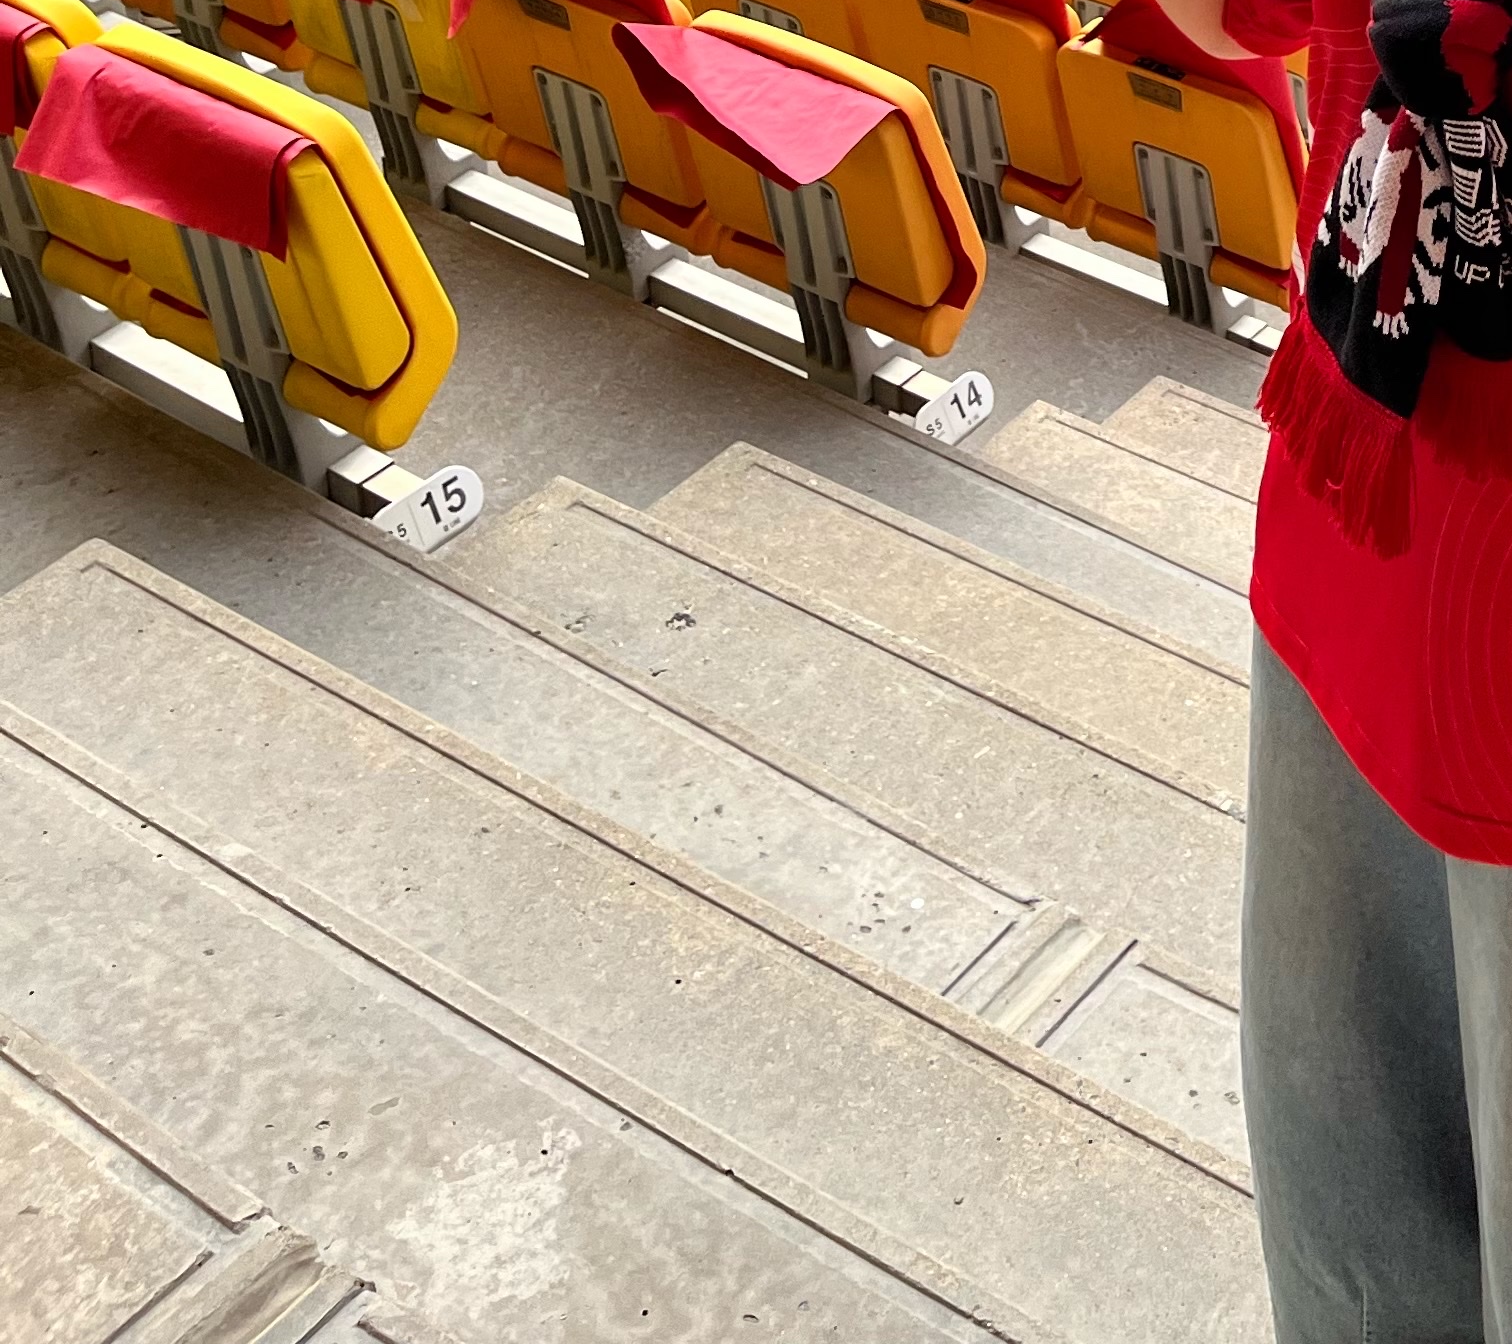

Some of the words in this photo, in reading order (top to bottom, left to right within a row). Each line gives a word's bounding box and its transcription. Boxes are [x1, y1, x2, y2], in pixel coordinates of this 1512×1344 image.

[950, 380, 983, 419] 14
[934, 417, 943, 430] 5
[420, 475, 467, 525] 15
[396, 523, 407, 538] 5
